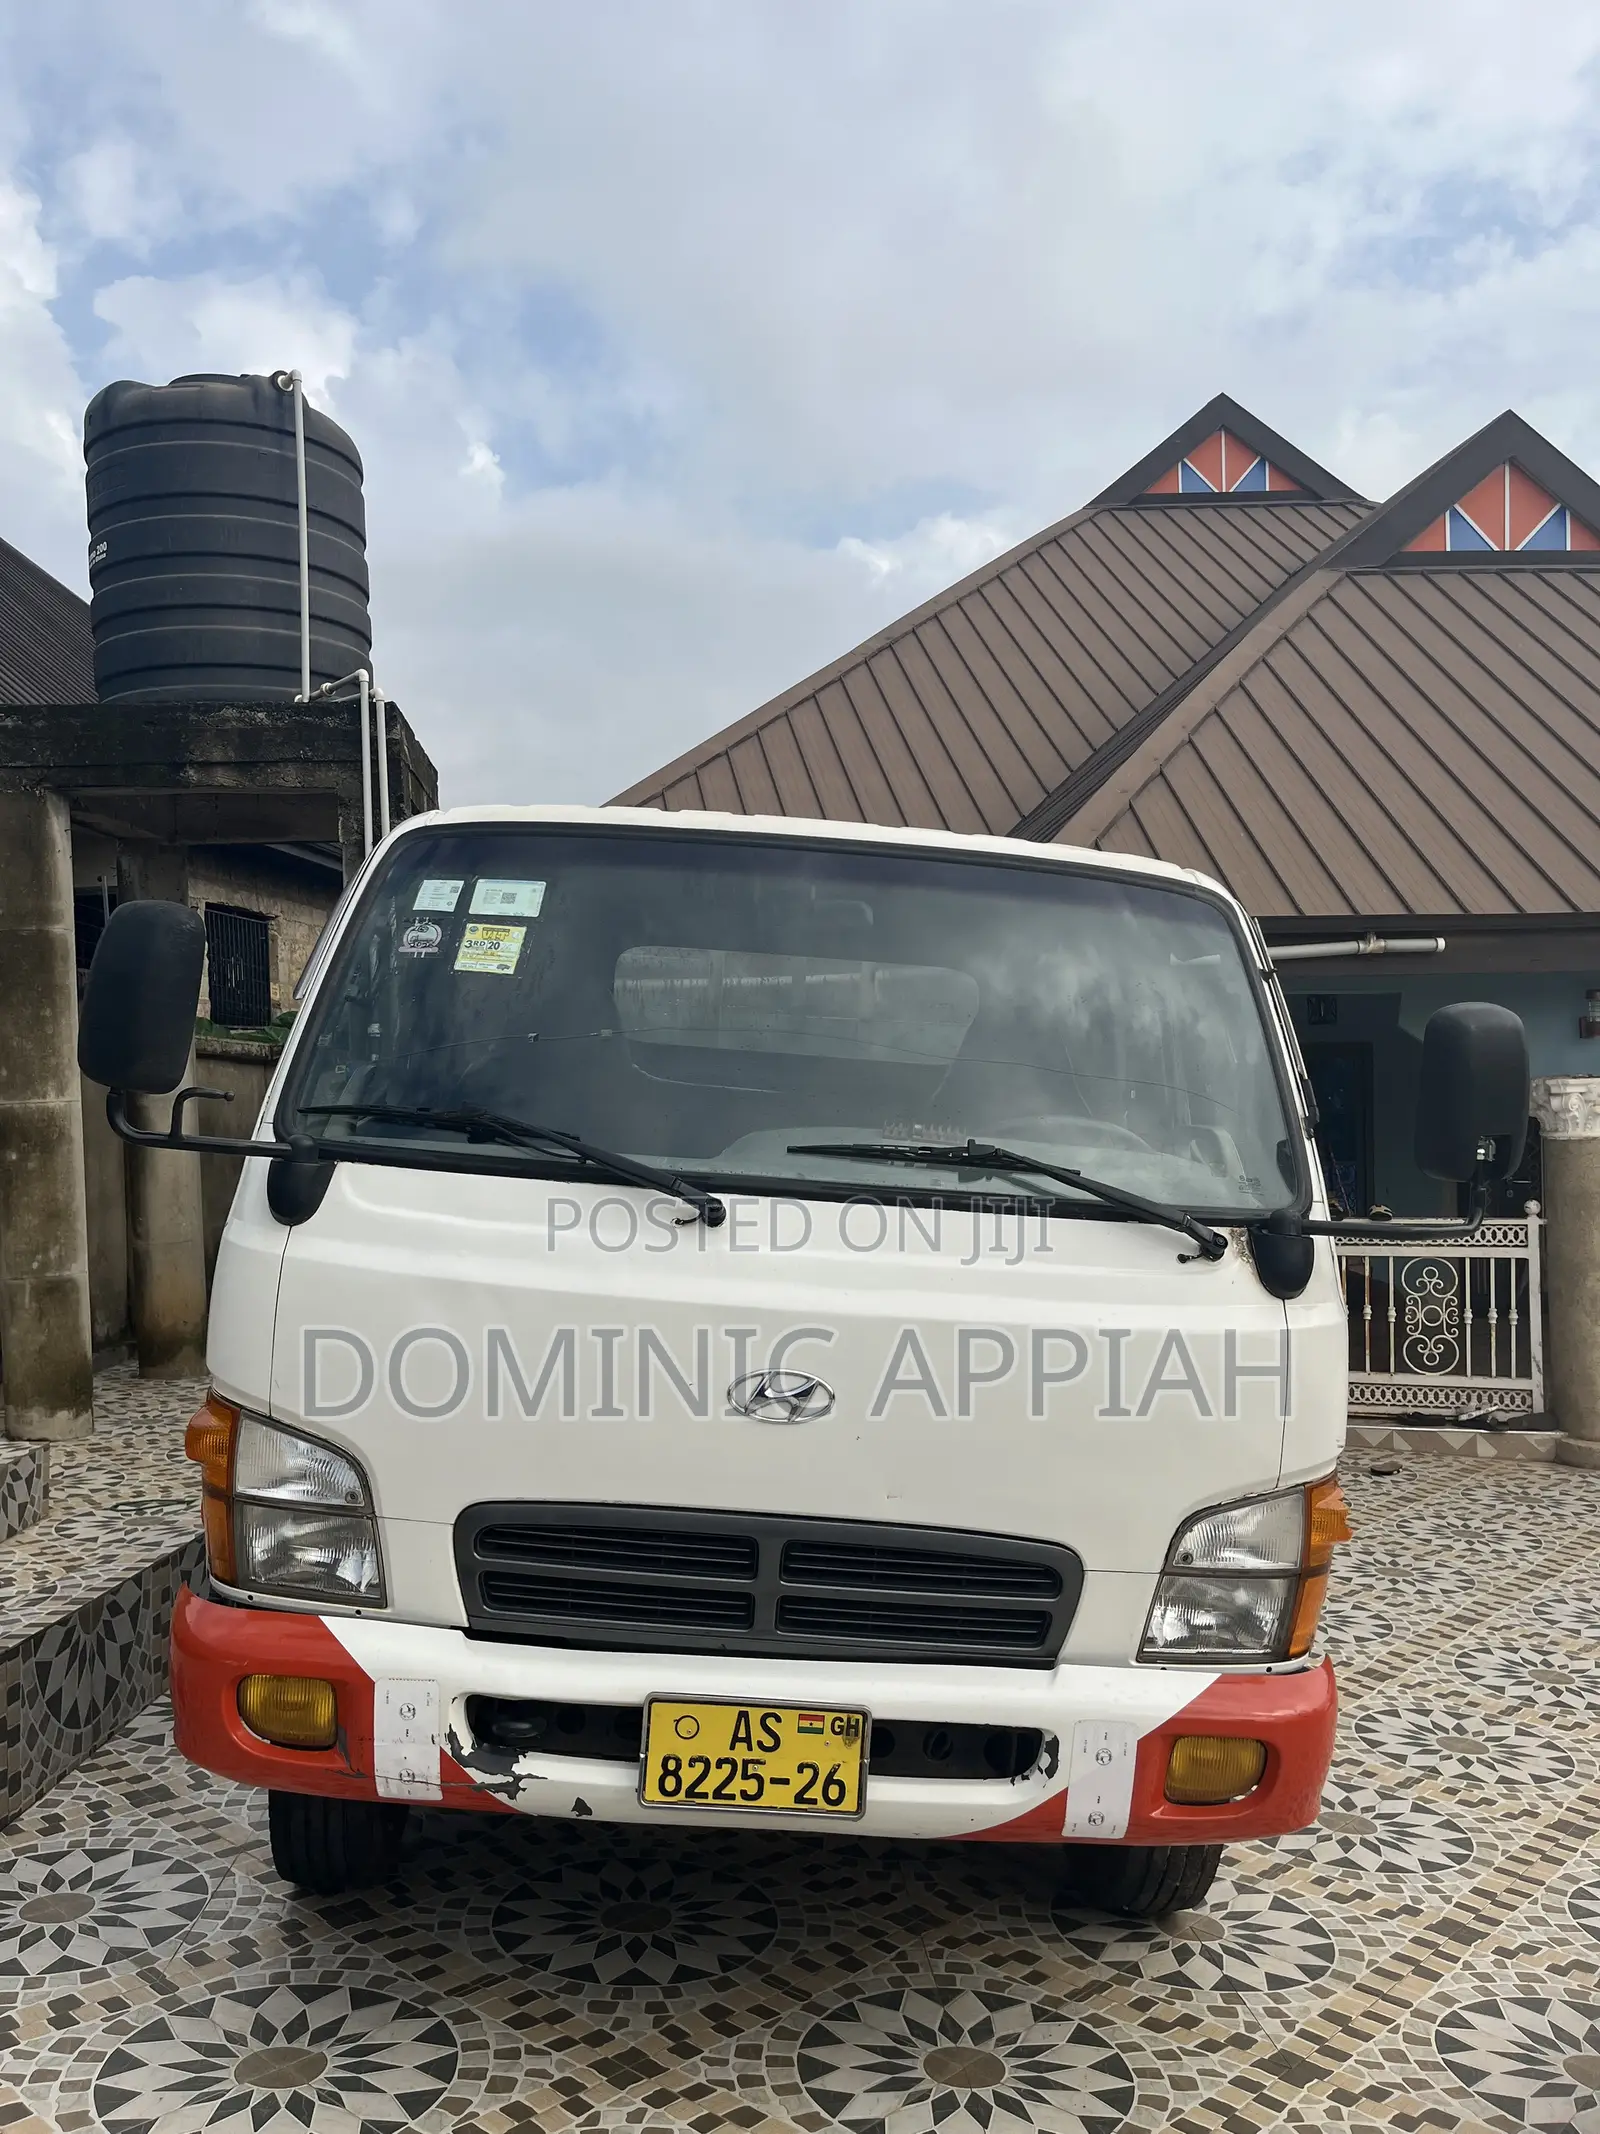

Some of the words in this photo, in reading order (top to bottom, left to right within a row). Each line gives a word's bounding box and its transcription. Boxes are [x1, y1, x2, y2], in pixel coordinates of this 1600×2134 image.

[96, 541, 108, 556] 200
[464, 940, 486, 948] 3RD
[729, 1710, 783, 1753] AS
[830, 1716, 860, 1738] GH
[657, 1753, 847, 1807] 8225-26
